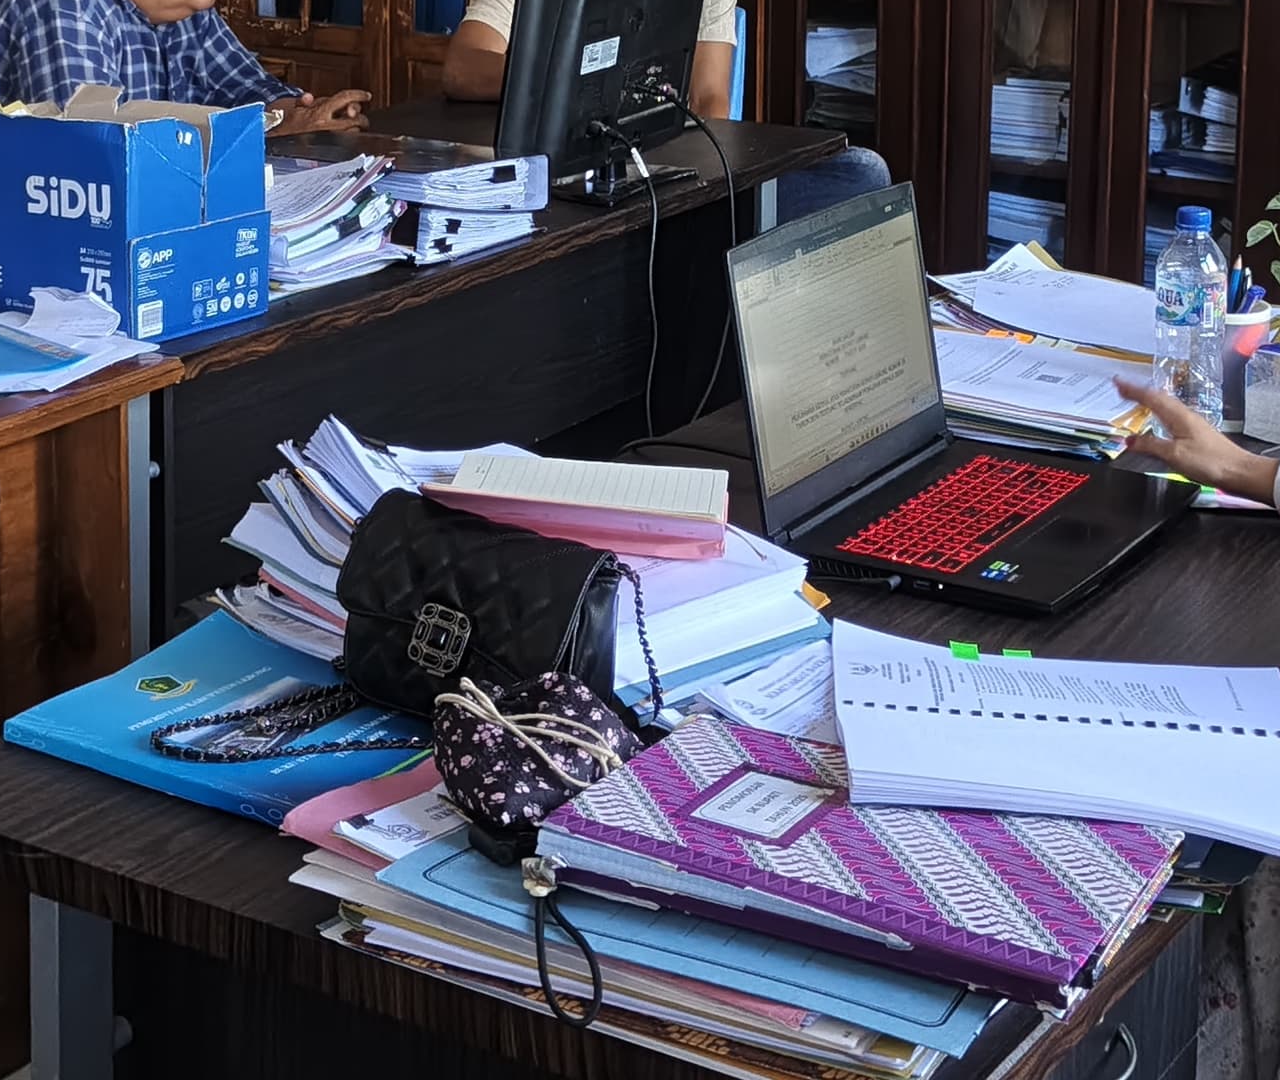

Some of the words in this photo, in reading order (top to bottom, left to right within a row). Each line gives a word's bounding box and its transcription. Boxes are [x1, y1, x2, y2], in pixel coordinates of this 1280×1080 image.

[152, 249, 173, 264] APP
[1158, 287, 1184, 307] QUA
[718, 781, 765, 812] PENOMORAN
[756, 790, 782, 810] BUPATI
[765, 802, 794, 823] TAHUN
